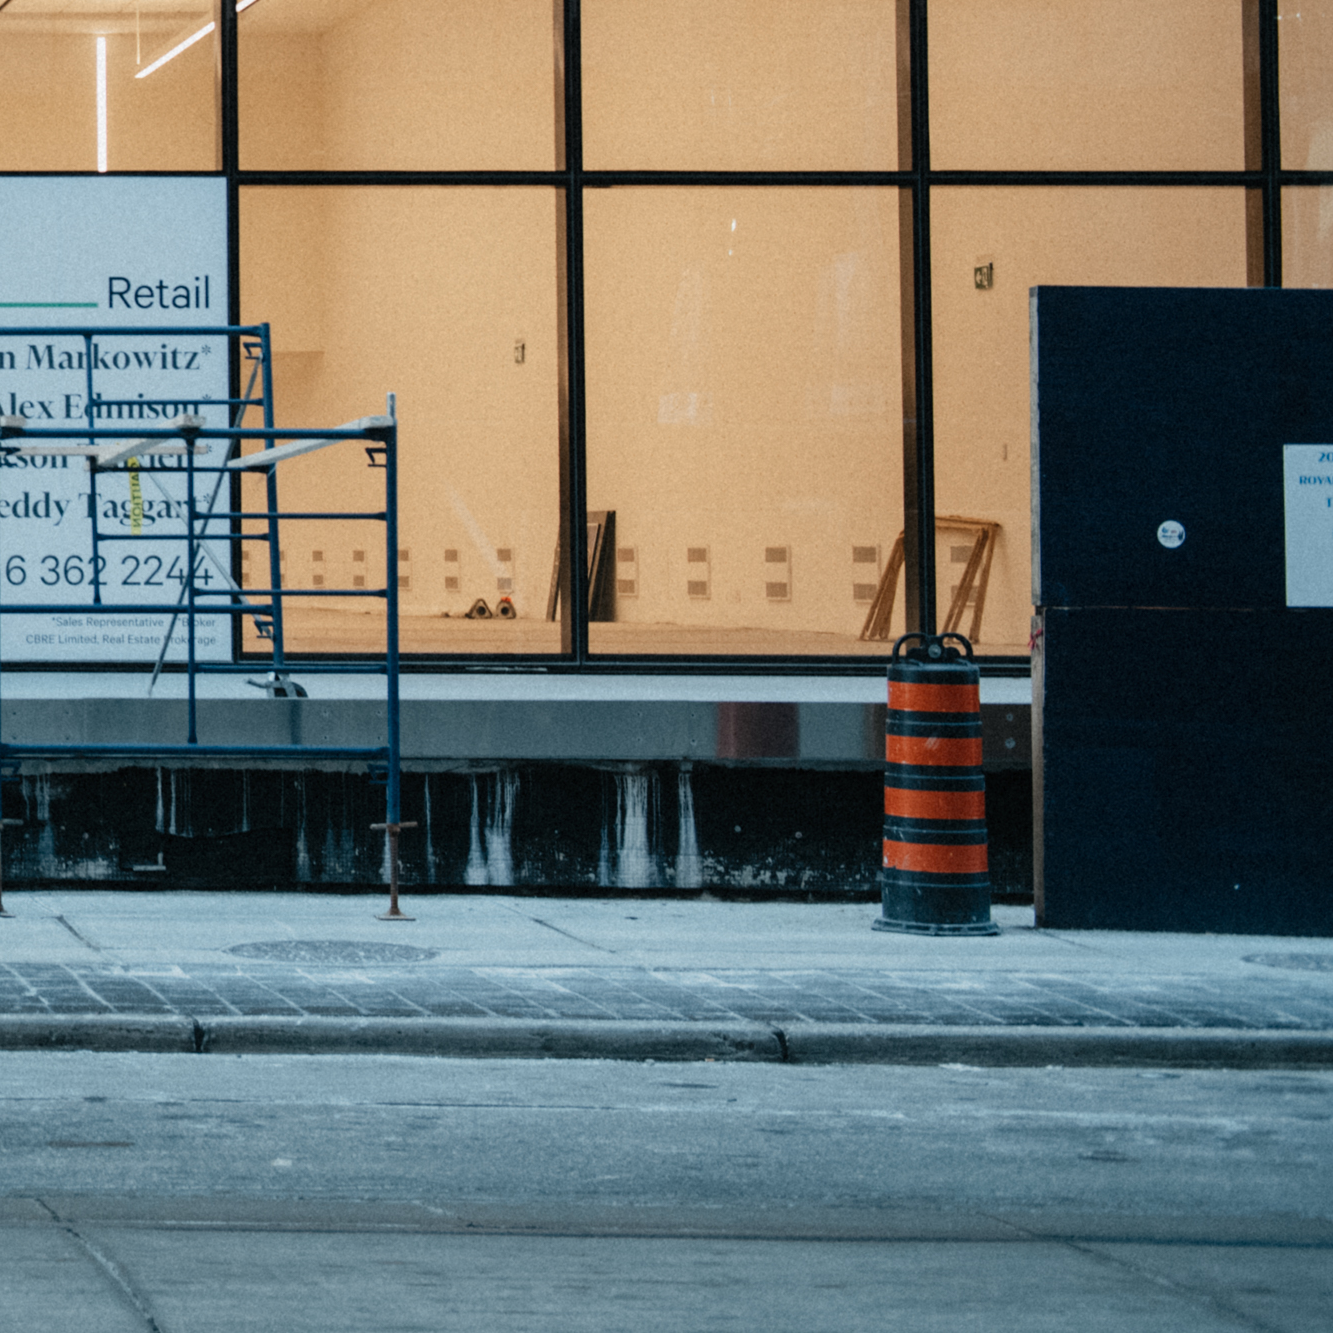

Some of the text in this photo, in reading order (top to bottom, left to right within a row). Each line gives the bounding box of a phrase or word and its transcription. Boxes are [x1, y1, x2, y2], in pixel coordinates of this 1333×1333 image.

[107, 275, 211, 309] Retail
[39, 553, 108, 586] 362
[120, 553, 214, 586] 2244
[86, 616, 165, 630] Representative
[25, 634, 55, 645] CBRE
[58, 634, 100, 646] Limited,
[102, 633, 125, 645] Real
[127, 634, 161, 645] Estate
